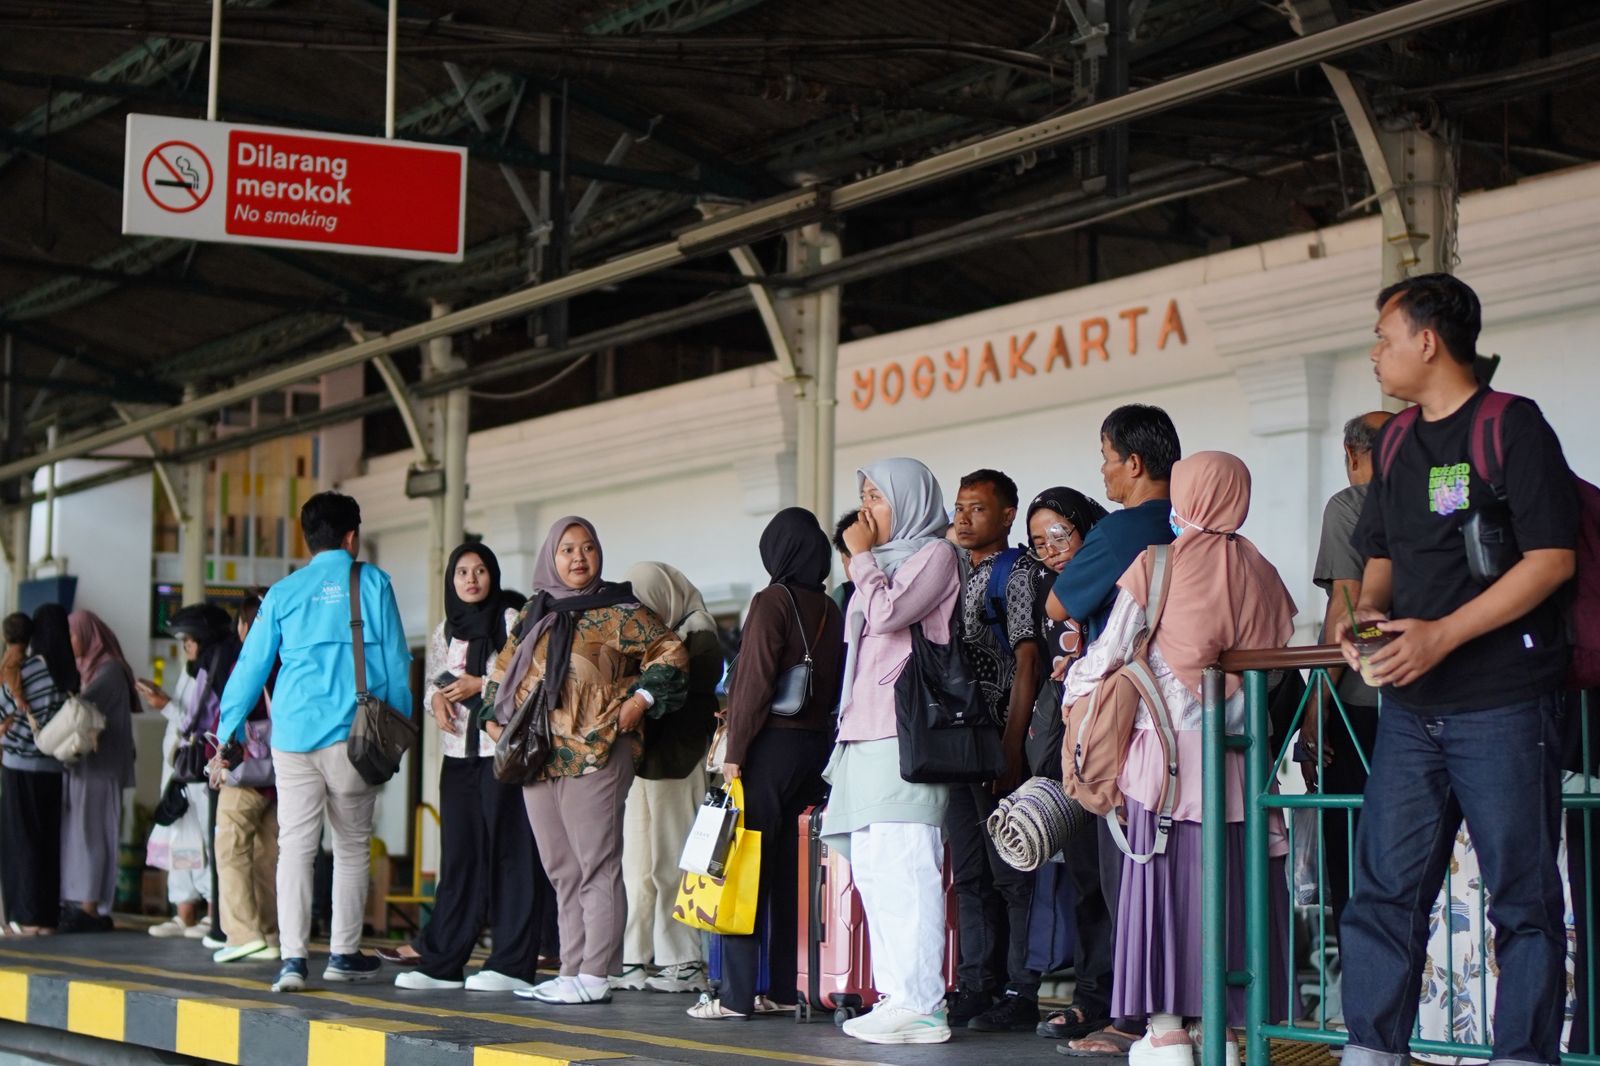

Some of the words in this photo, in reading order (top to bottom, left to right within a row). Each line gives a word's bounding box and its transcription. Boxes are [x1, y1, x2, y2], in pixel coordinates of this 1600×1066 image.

[237, 142, 348, 180] Dilarang
[236, 178, 351, 205] merokok
[234, 204, 260, 222] No
[263, 208, 338, 233] smoking
[851, 298, 1188, 412] YOGYAKARTA
